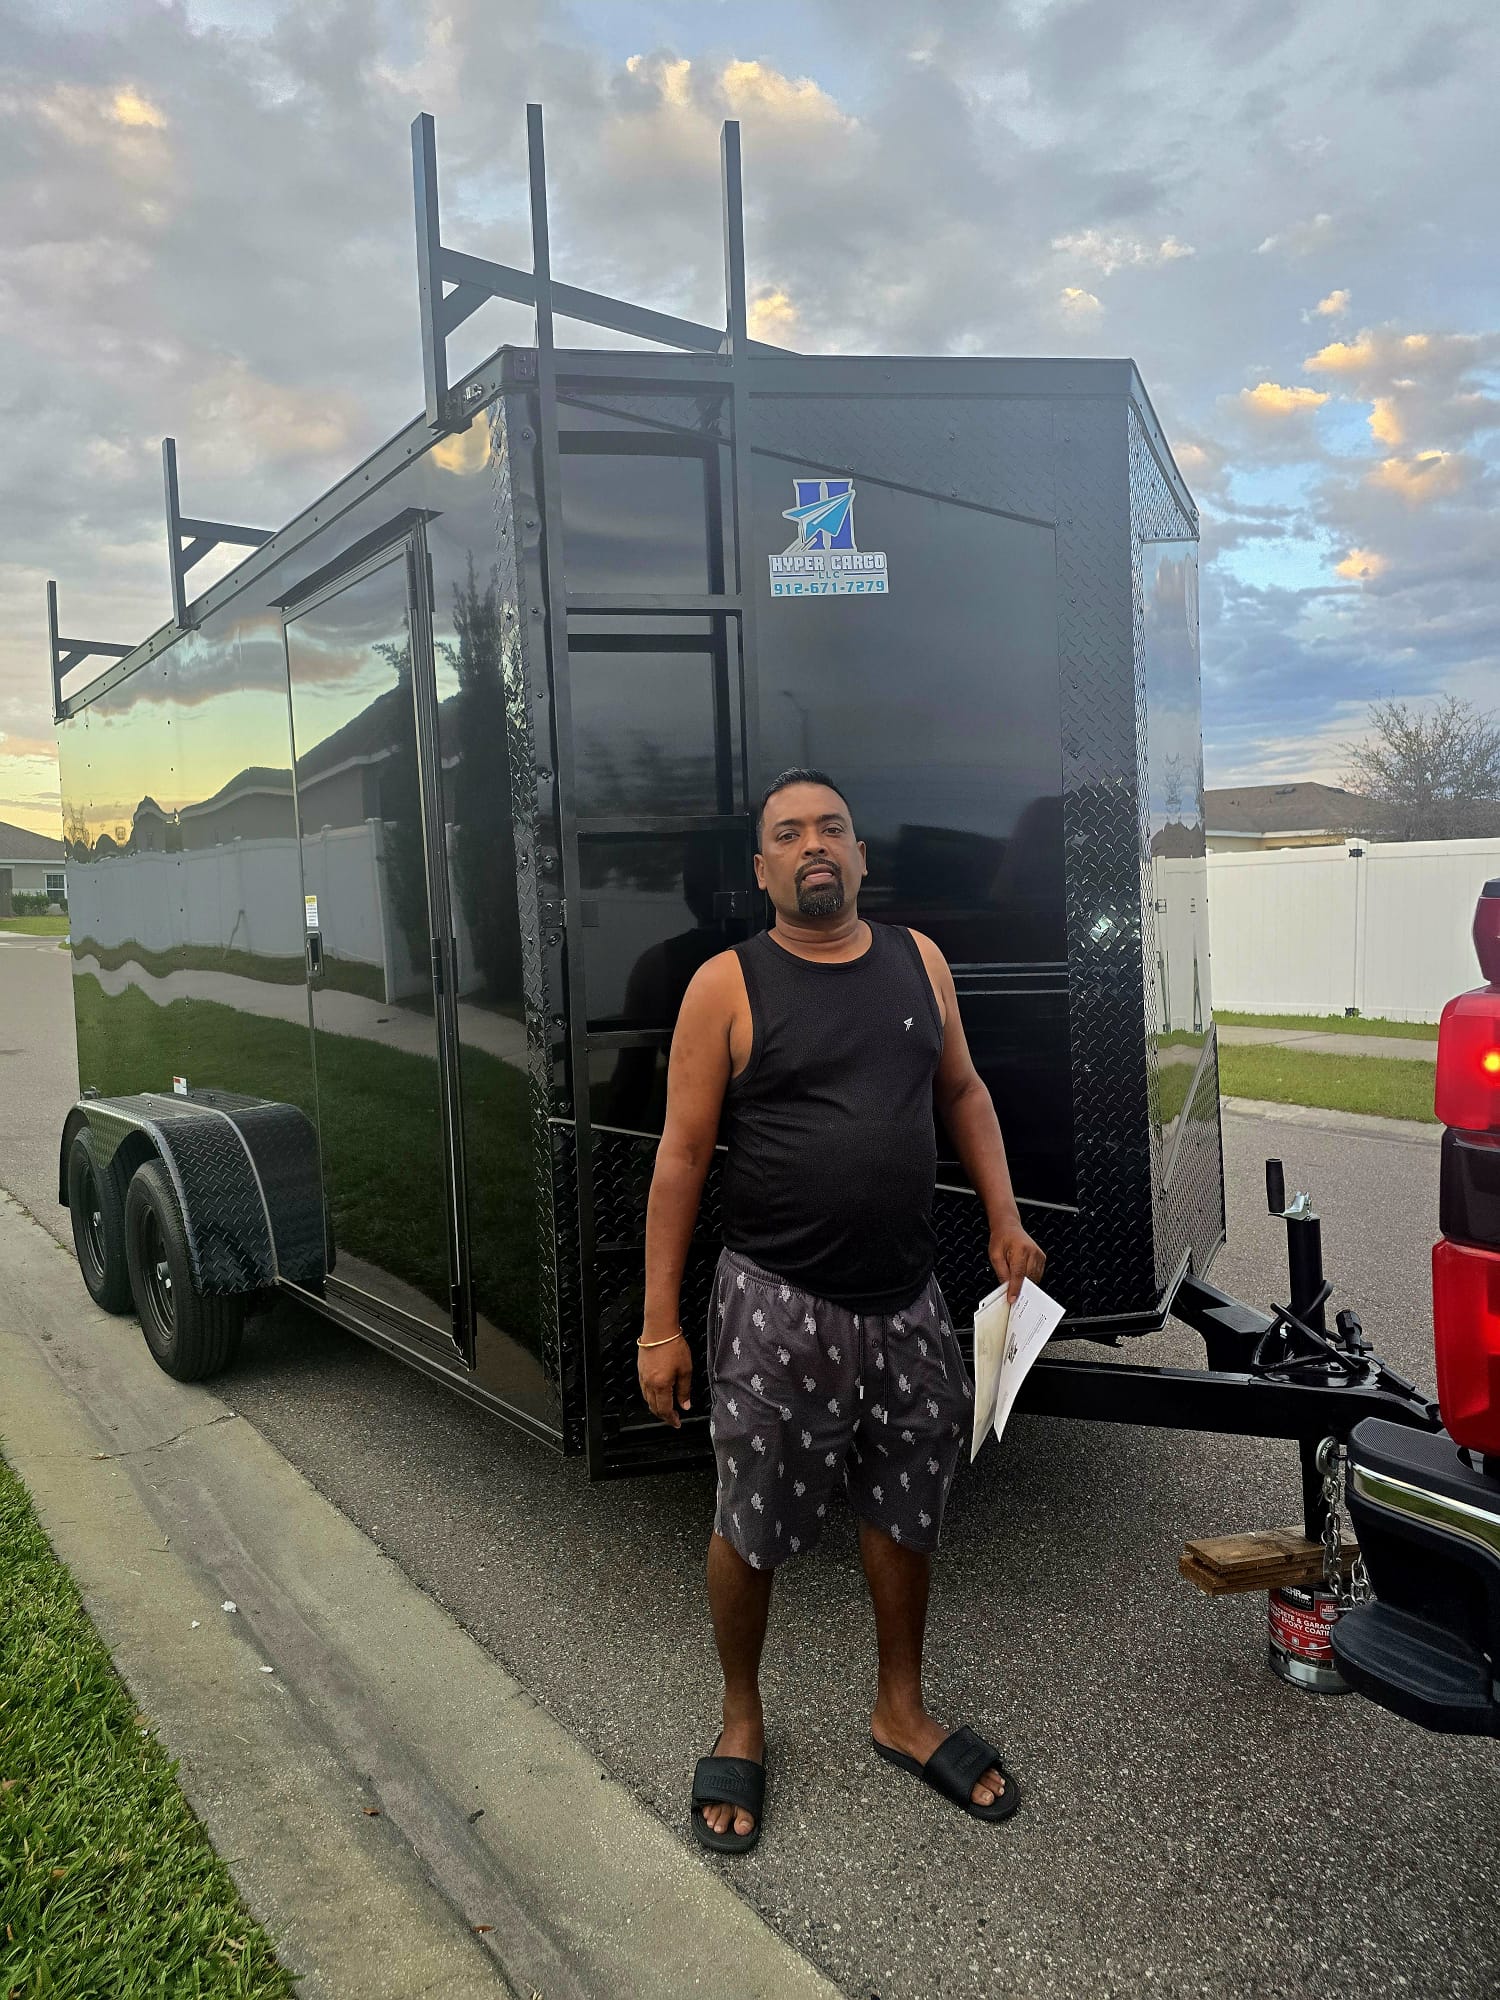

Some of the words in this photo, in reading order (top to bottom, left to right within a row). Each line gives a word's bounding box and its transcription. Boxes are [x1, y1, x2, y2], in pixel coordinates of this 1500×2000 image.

[772, 556, 825, 572] HYPER
[831, 554, 886, 571] CARGO
[818, 571, 840, 579] LLC
[774, 580, 885, 595] 912-671-7279
[1281, 1616, 1303, 1631] EPOXY
